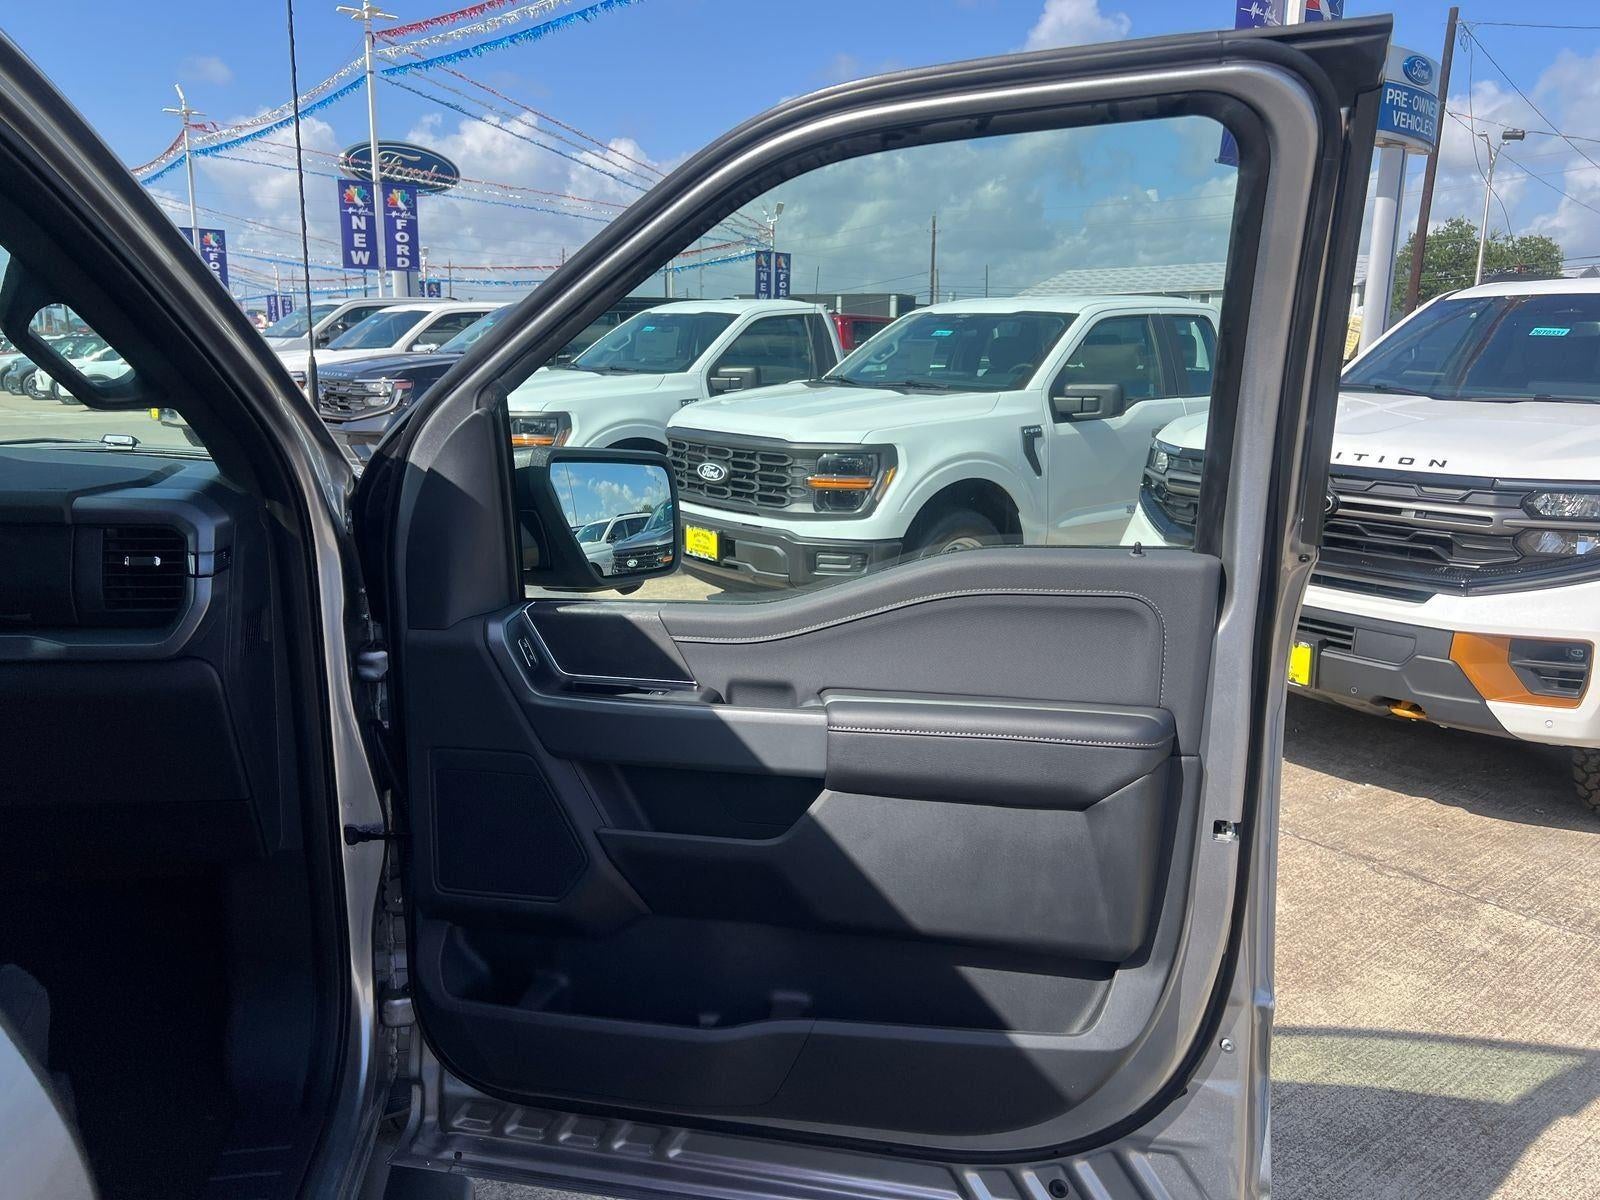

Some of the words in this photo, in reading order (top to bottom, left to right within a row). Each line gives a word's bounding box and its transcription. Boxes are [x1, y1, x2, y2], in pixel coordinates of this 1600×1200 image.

[1393, 110, 1432, 136] VEHICLES
[351, 216, 370, 265] NEW
[395, 219, 410, 267] FORD
[759, 272, 768, 299] NEW
[702, 465, 720, 479] Ford
